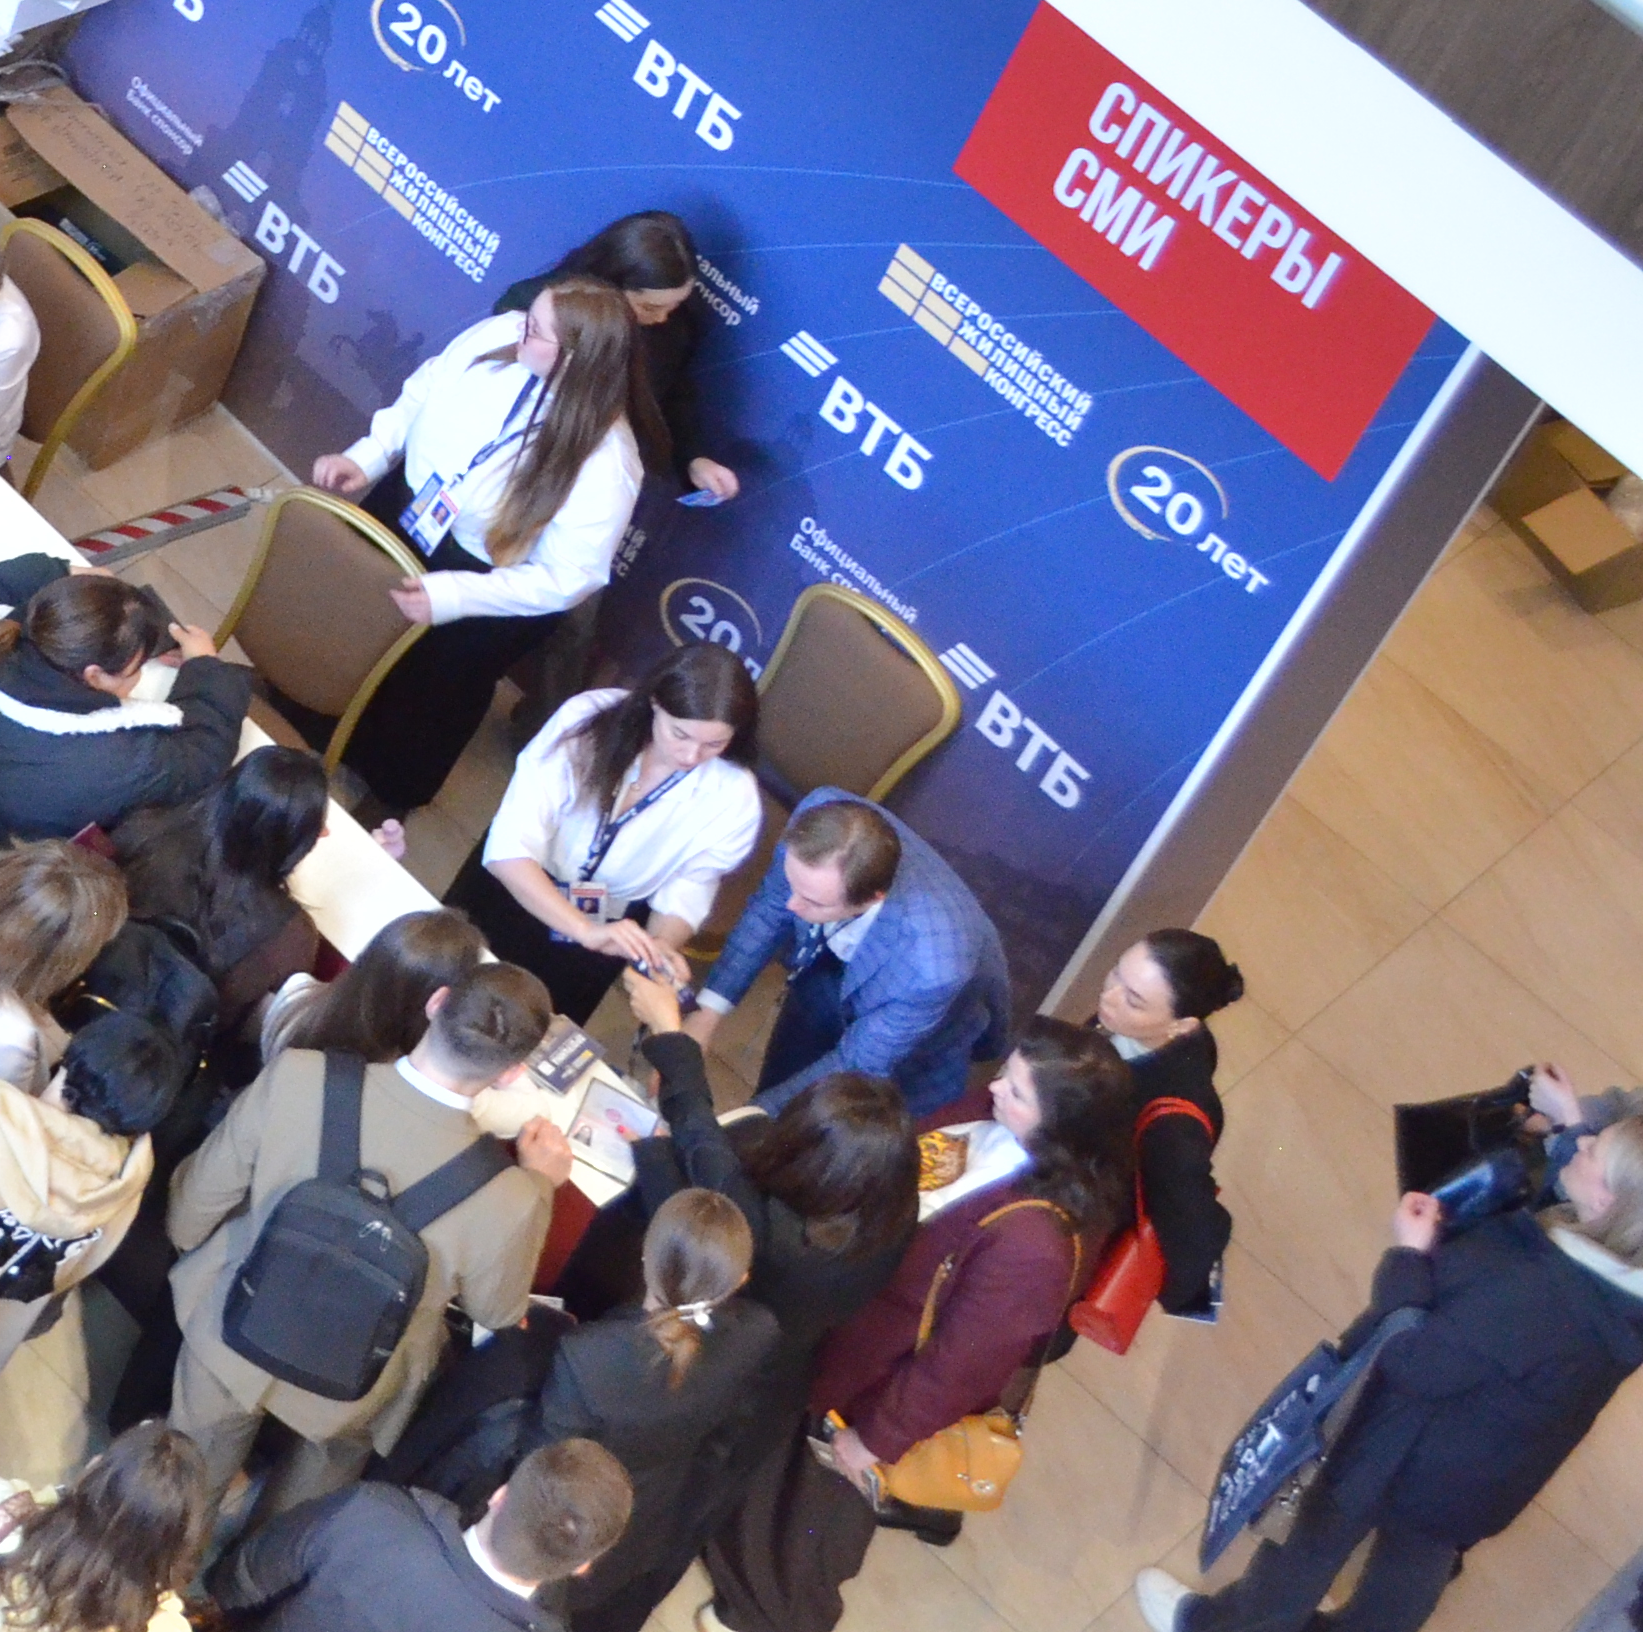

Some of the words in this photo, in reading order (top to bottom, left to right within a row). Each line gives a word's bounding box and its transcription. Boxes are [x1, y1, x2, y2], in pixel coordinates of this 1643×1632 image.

[389, 2, 446, 64] 20
[443, 60, 501, 113] лет
[633, 39, 742, 151] ВТБ
[365, 127, 501, 254] ВСЕРОССИЙСКИЙ
[389, 169, 494, 268] ЖИЛИЩНЫЙ
[1053, 147, 1176, 272] СМИ
[1088, 82, 1342, 310] СПИКЕРЫ
[255, 200, 346, 304] ВТБ
[411, 212, 486, 283] КОНГРЕСС
[696, 255, 761, 316] альный
[929, 272, 1094, 415] ВСЕРОССИЙСКИЙ
[956, 319, 1083, 432] ЖИЛИЩНЫЙ
[818, 376, 933, 490] ВТБ
[984, 366, 1073, 448] КОНГРЕСС
[790, 533, 831, 576] Банк
[800, 517, 918, 624] Официальный
[1130, 465, 1203, 535] 20
[1196, 532, 1271, 594] лет
[679, 596, 741, 653] 20
[974, 690, 1092, 809] ВТБ
